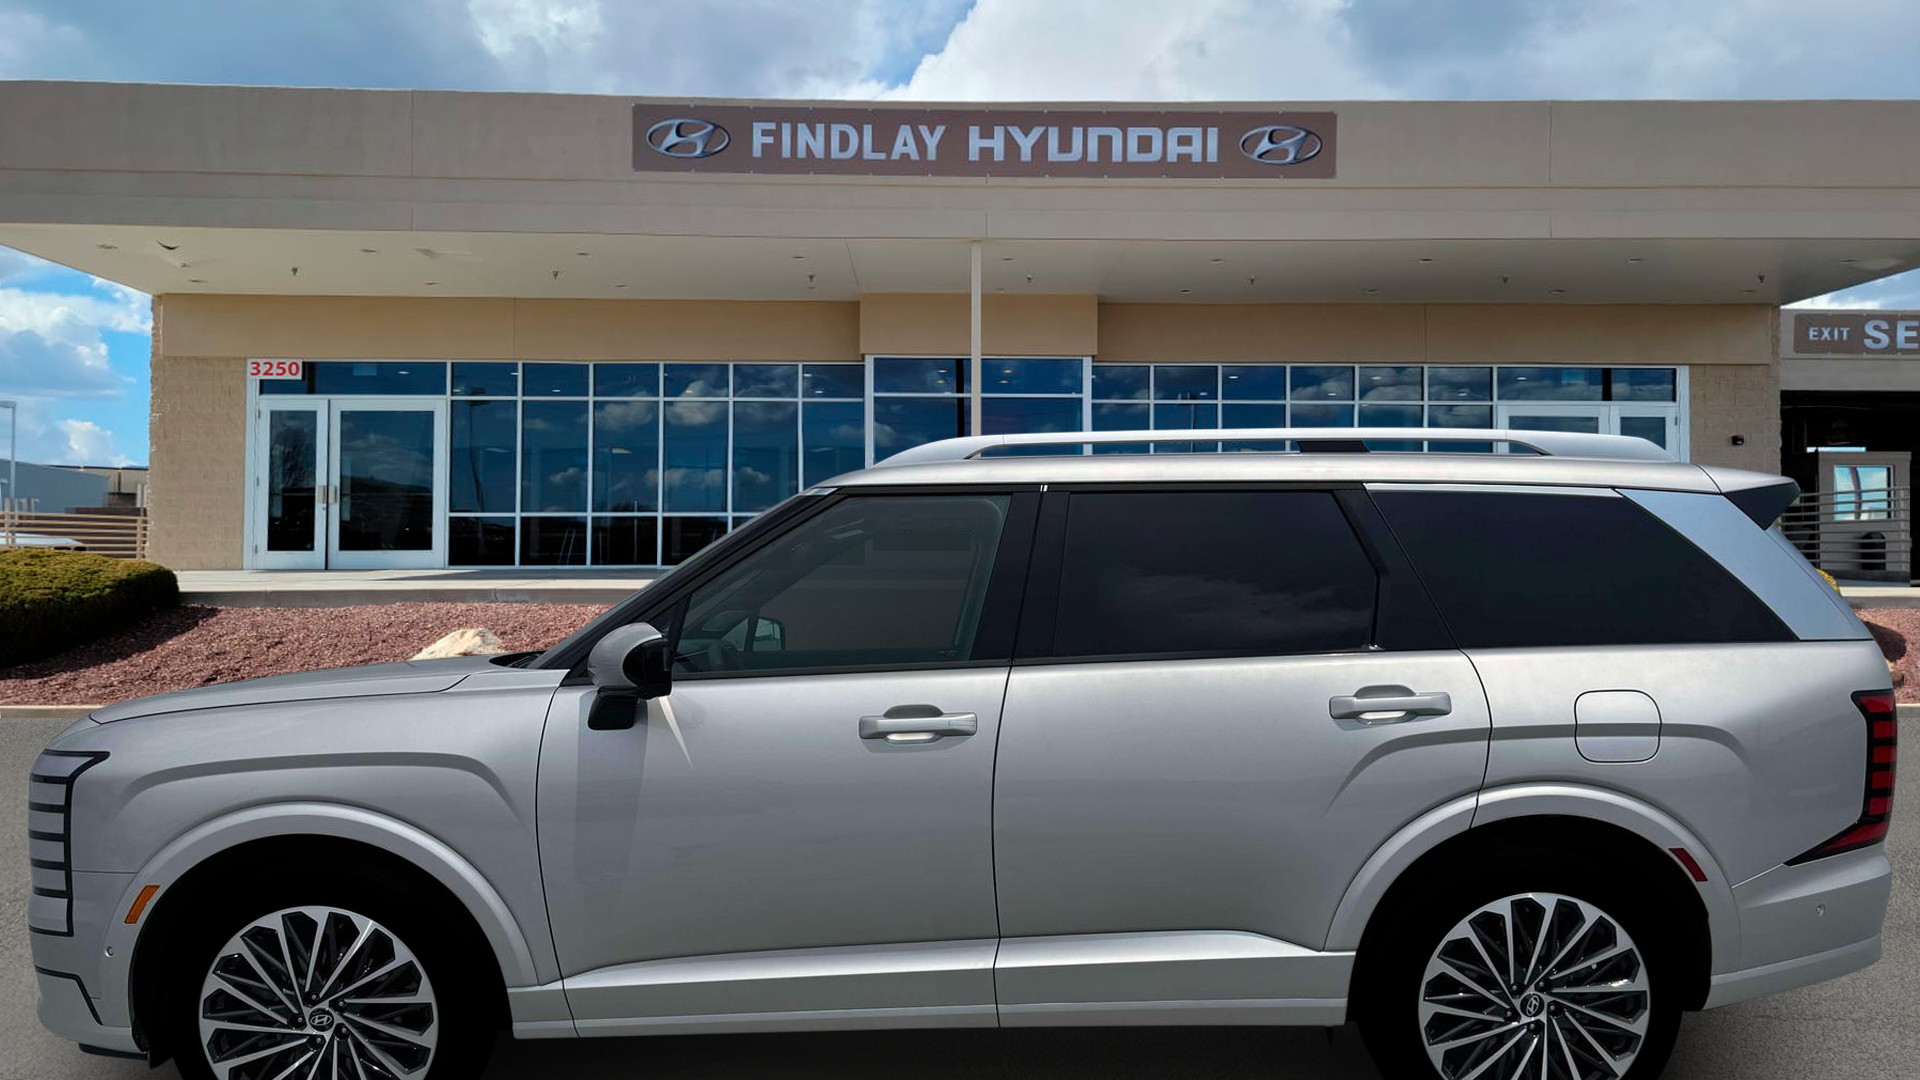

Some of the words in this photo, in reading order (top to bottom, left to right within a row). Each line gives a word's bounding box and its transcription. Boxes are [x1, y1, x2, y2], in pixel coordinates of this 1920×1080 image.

[752, 122, 945, 160] FINDLAY
[968, 125, 1218, 163] HYUNDAI
[1808, 326, 1850, 341] EXIT
[250, 361, 300, 376] 3250
